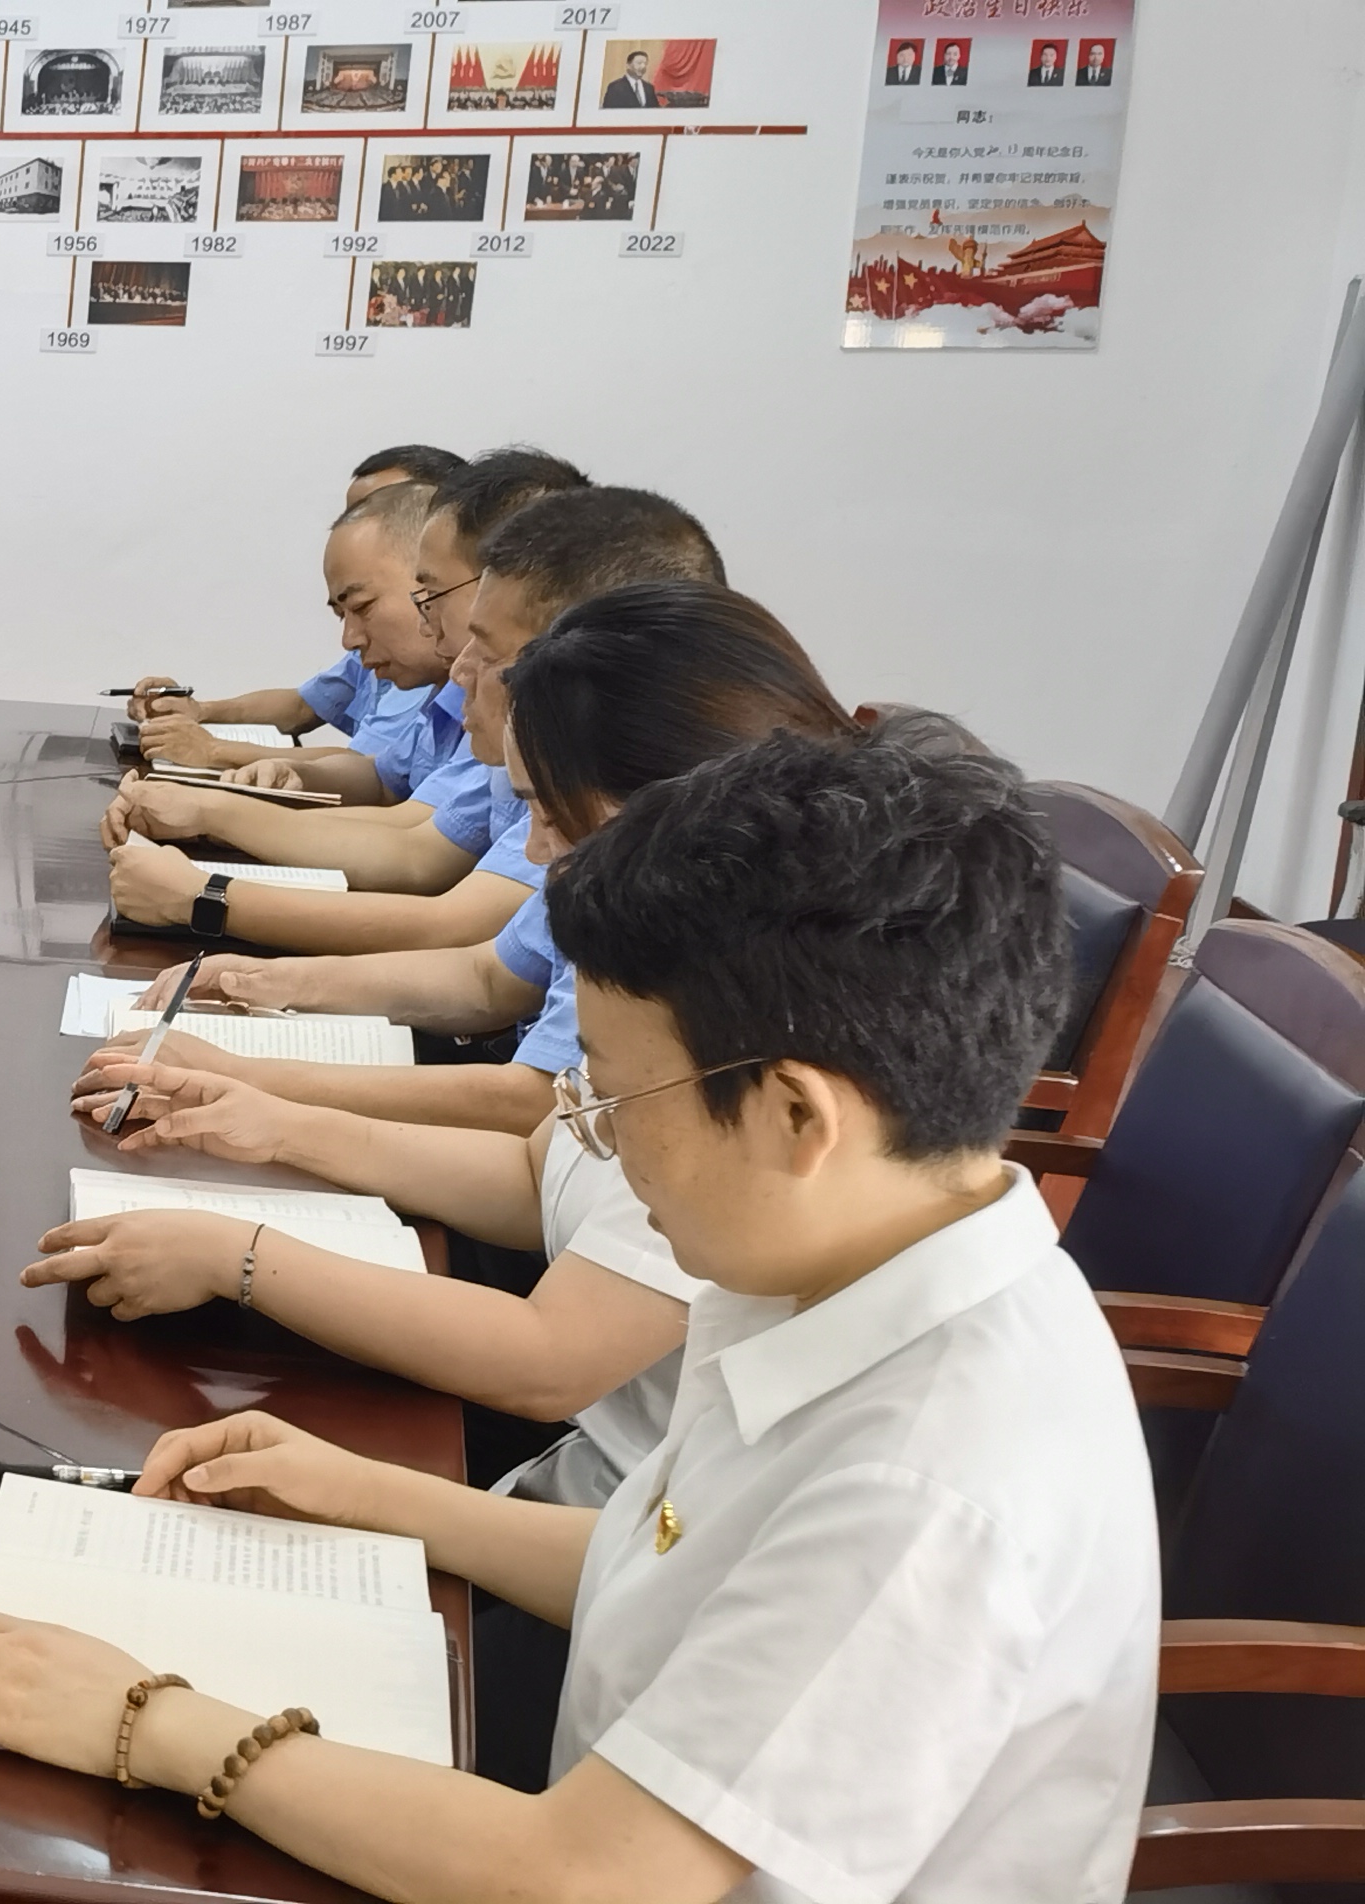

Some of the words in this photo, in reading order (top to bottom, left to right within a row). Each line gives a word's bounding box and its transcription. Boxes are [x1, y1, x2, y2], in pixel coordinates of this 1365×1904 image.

[265, 14, 312, 31] 1987
[410, 11, 460, 28] 2007
[561, 8, 612, 26] 2017
[124, 17, 171, 35] 1977
[54, 235, 98, 252] 1956
[191, 236, 237, 253] 1982
[331, 236, 379, 253] 1992
[476, 235, 526, 252] 2012
[626, 235, 676, 252] 2022
[47, 331, 90, 348] 1969
[322, 335, 369, 352] 1997
